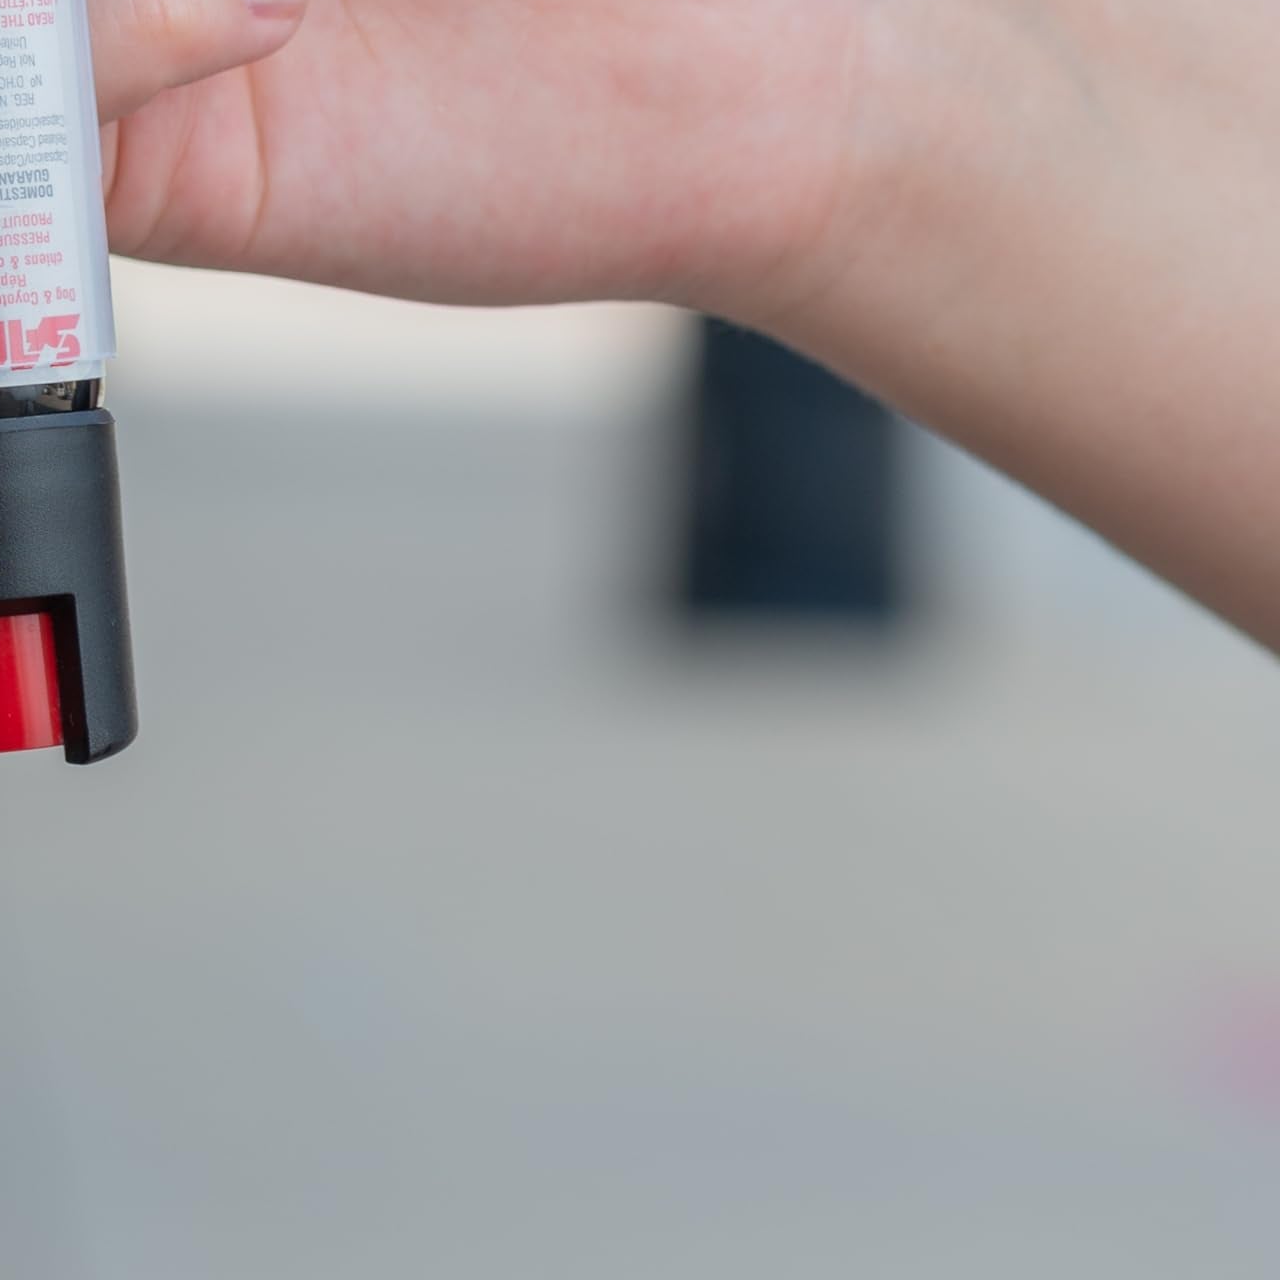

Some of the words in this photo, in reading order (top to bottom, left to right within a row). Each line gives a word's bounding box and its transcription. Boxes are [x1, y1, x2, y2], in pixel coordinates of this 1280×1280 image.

[1, 14, 24, 29] THE
[28, 12, 54, 26] READ
[21, 54, 35, 67] Not
[3, 212, 53, 229] PRODUIT
[10, 256, 19, 269] &
[24, 252, 62, 267] chiens
[44, 291, 51, 304] &
[56, 287, 75, 302] Dog
